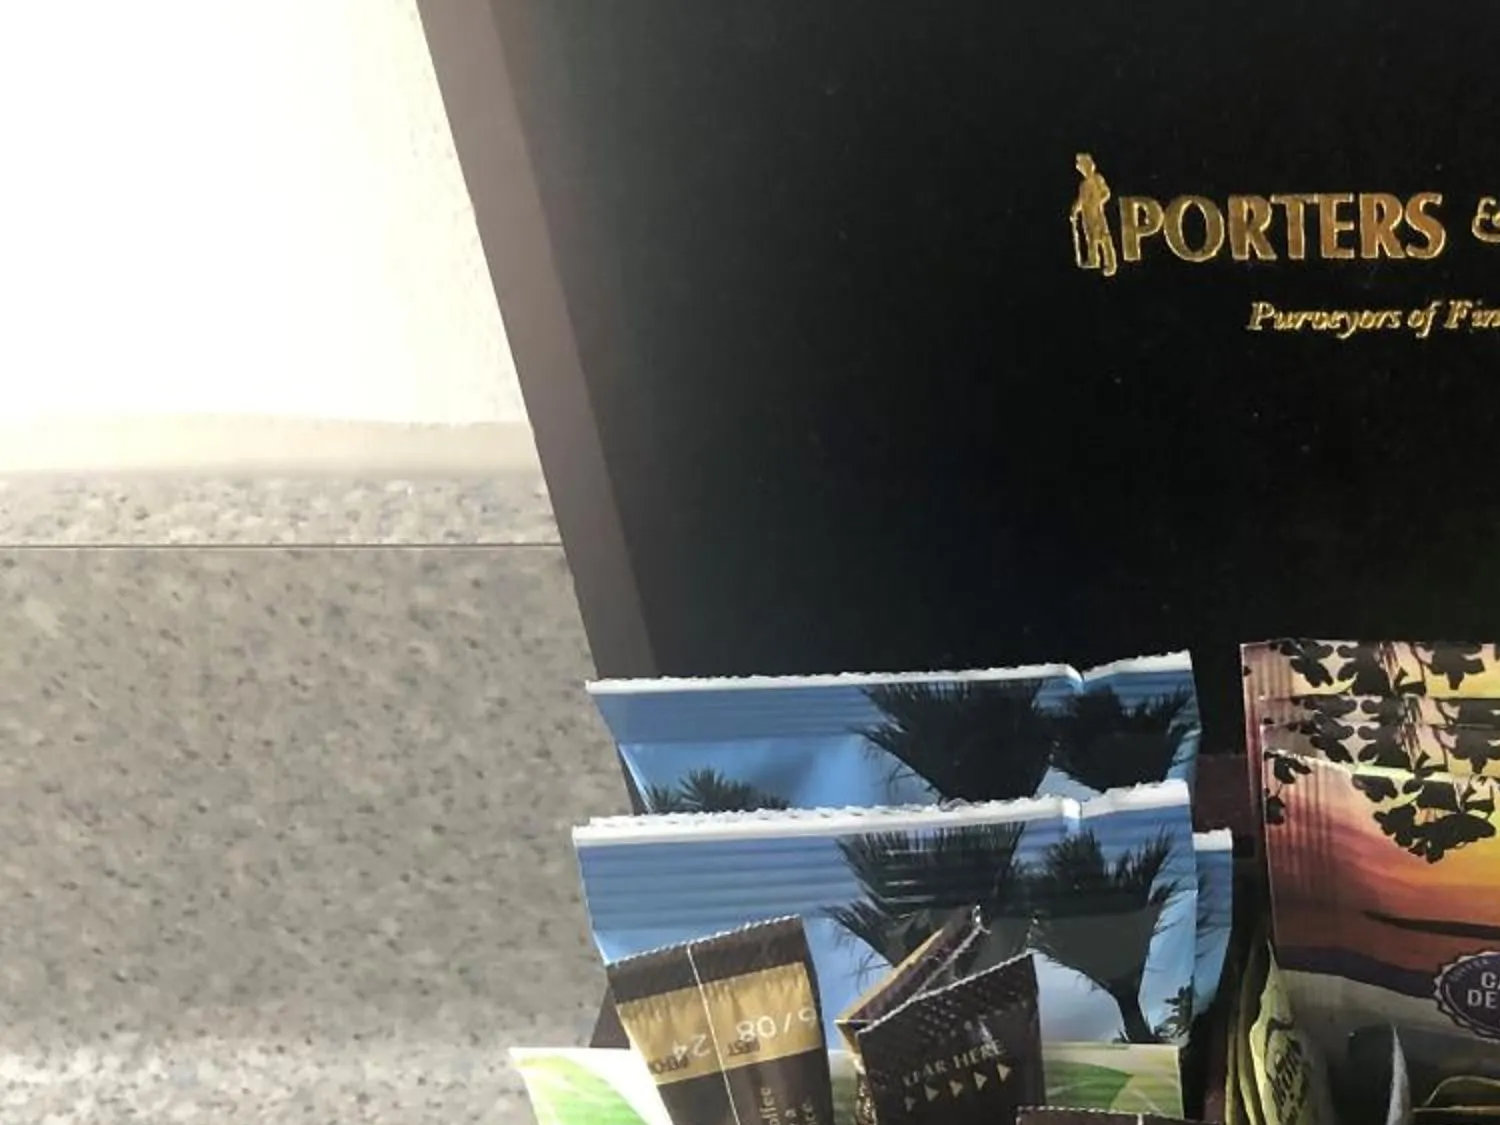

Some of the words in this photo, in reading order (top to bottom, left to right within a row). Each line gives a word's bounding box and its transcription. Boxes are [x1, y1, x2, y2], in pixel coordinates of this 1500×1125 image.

[1119, 192, 1446, 263] PORTERS
[1247, 301, 1402, 340] Purveyors
[1407, 301, 1441, 338] of
[1467, 989, 1498, 1009] DE
